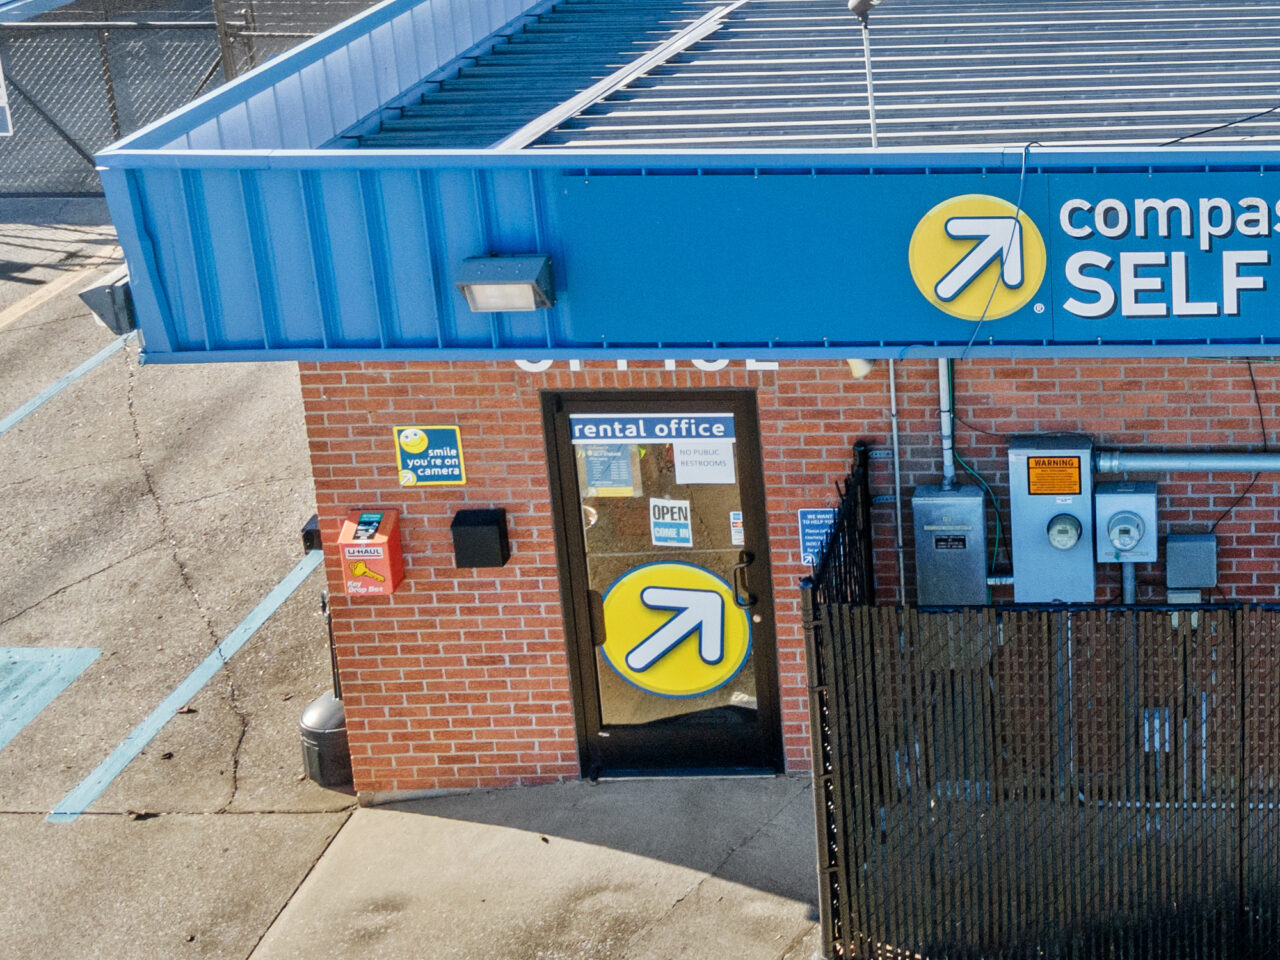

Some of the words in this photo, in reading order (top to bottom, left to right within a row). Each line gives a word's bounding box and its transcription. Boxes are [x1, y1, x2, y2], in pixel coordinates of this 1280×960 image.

[1062, 249, 1269, 318] SELF
[573, 419, 647, 437] rental
[654, 418, 726, 437] office
[428, 446, 457, 457] smile
[406, 457, 442, 468] you're
[444, 458, 459, 466] on
[1034, 459, 1074, 467] WARNING
[417, 467, 460, 476] camera
[652, 504, 689, 521] OPEN
[654, 527, 678, 538] COME
[679, 528, 690, 538] IN
